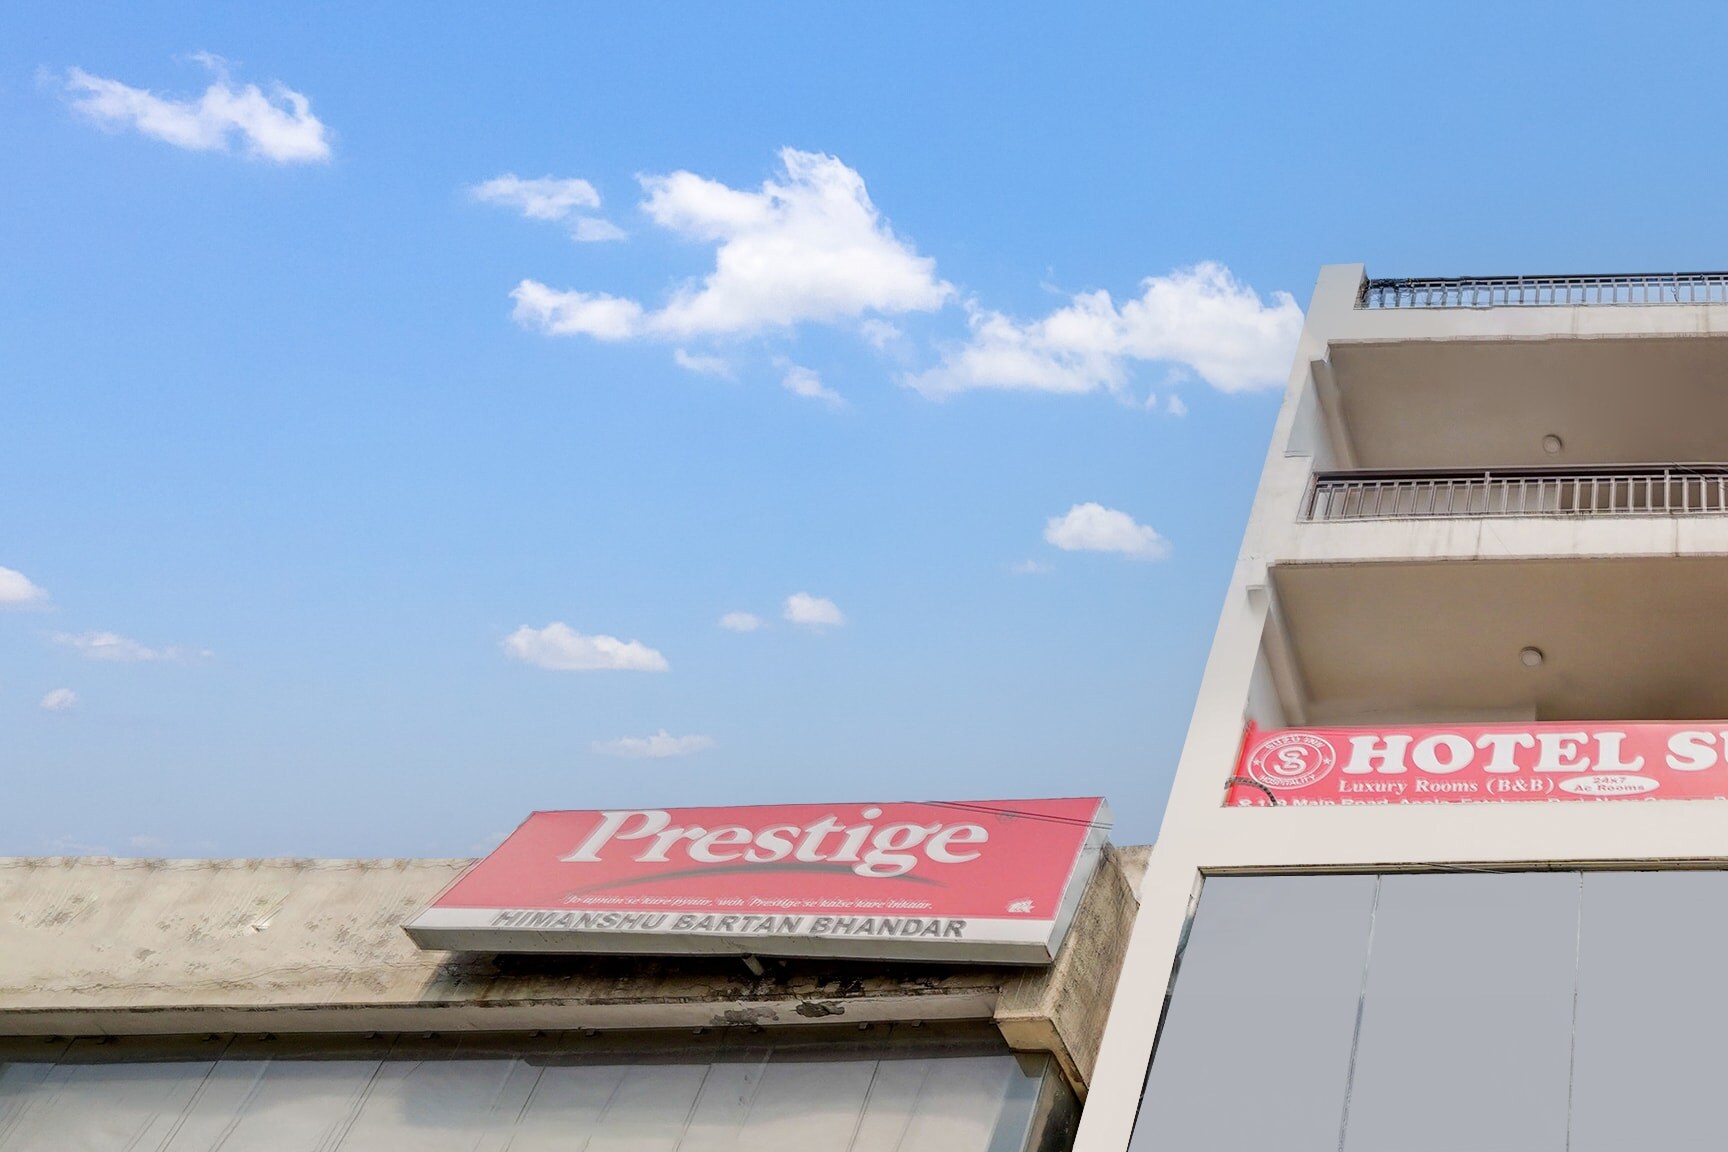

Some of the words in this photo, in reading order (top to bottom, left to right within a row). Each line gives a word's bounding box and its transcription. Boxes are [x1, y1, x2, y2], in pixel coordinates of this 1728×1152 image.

[1343, 731, 1646, 774] HOTEL
[1338, 778, 1407, 795] Luxury
[1415, 778, 1479, 794] Rooms
[1486, 776, 1556, 796] (B&B)
[560, 807, 990, 878] Prestige
[490, 911, 667, 930] HIMANSHU
[671, 914, 802, 934] BARTAN
[808, 916, 968, 938] BHANDAR
